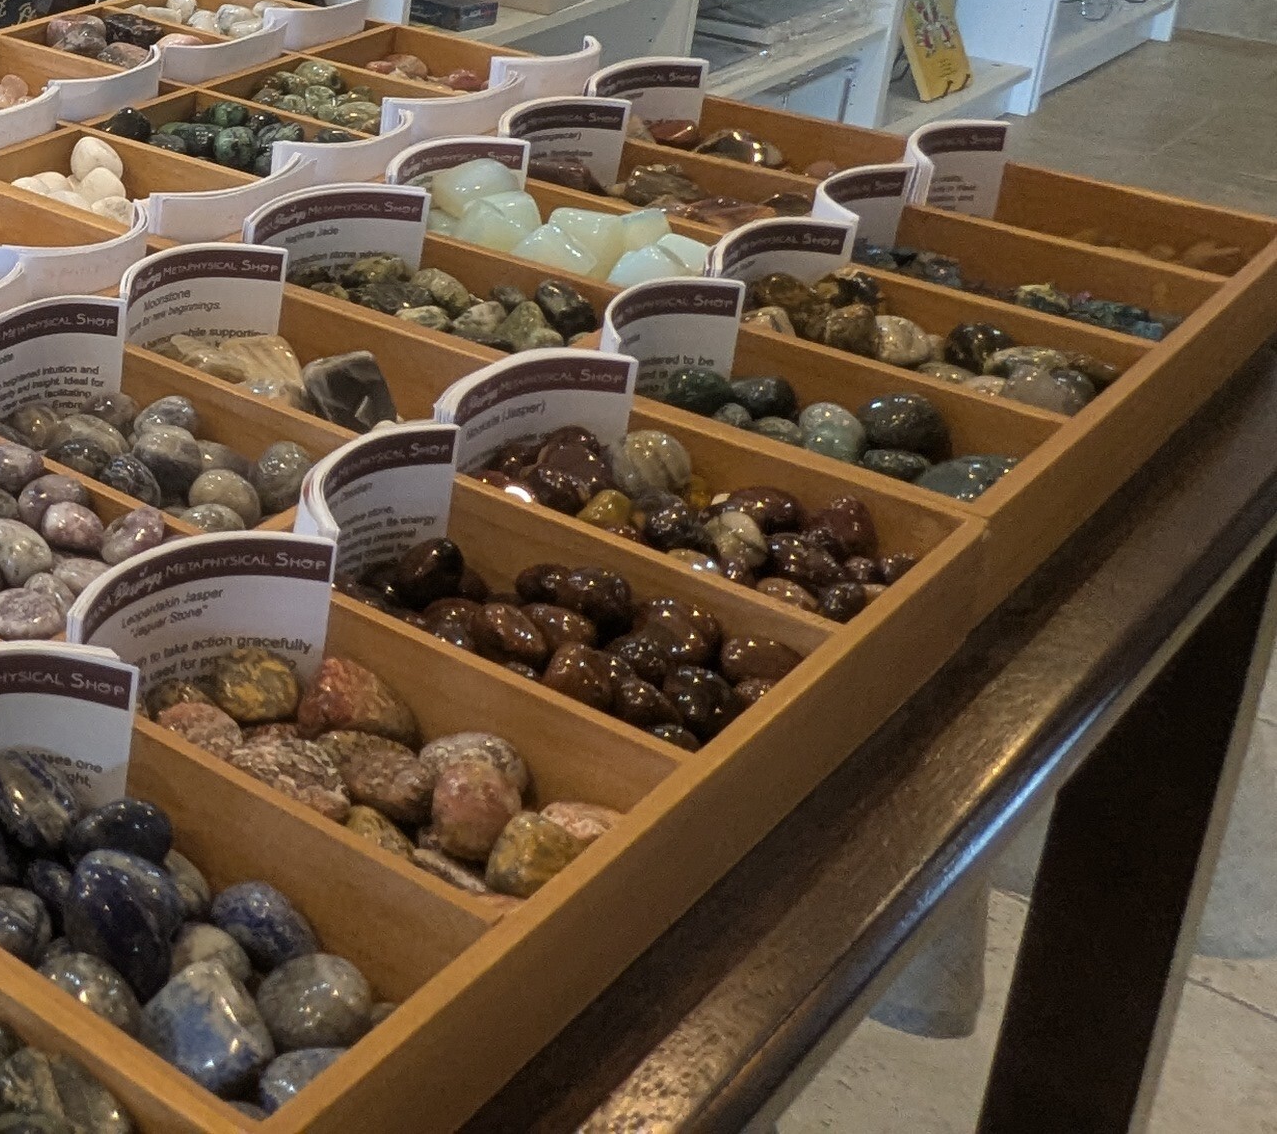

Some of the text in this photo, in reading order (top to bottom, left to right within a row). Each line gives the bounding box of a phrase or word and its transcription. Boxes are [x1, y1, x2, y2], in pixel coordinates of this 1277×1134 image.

[241, 260, 278, 274] SHOP
[76, 313, 115, 327] SHOP
[166, 552, 327, 579] METAPHYSICAL SHOP
[184, 587, 224, 604] Jasper
[238, 637, 311, 655] gracefully
[71, 673, 125, 696] SHOP
